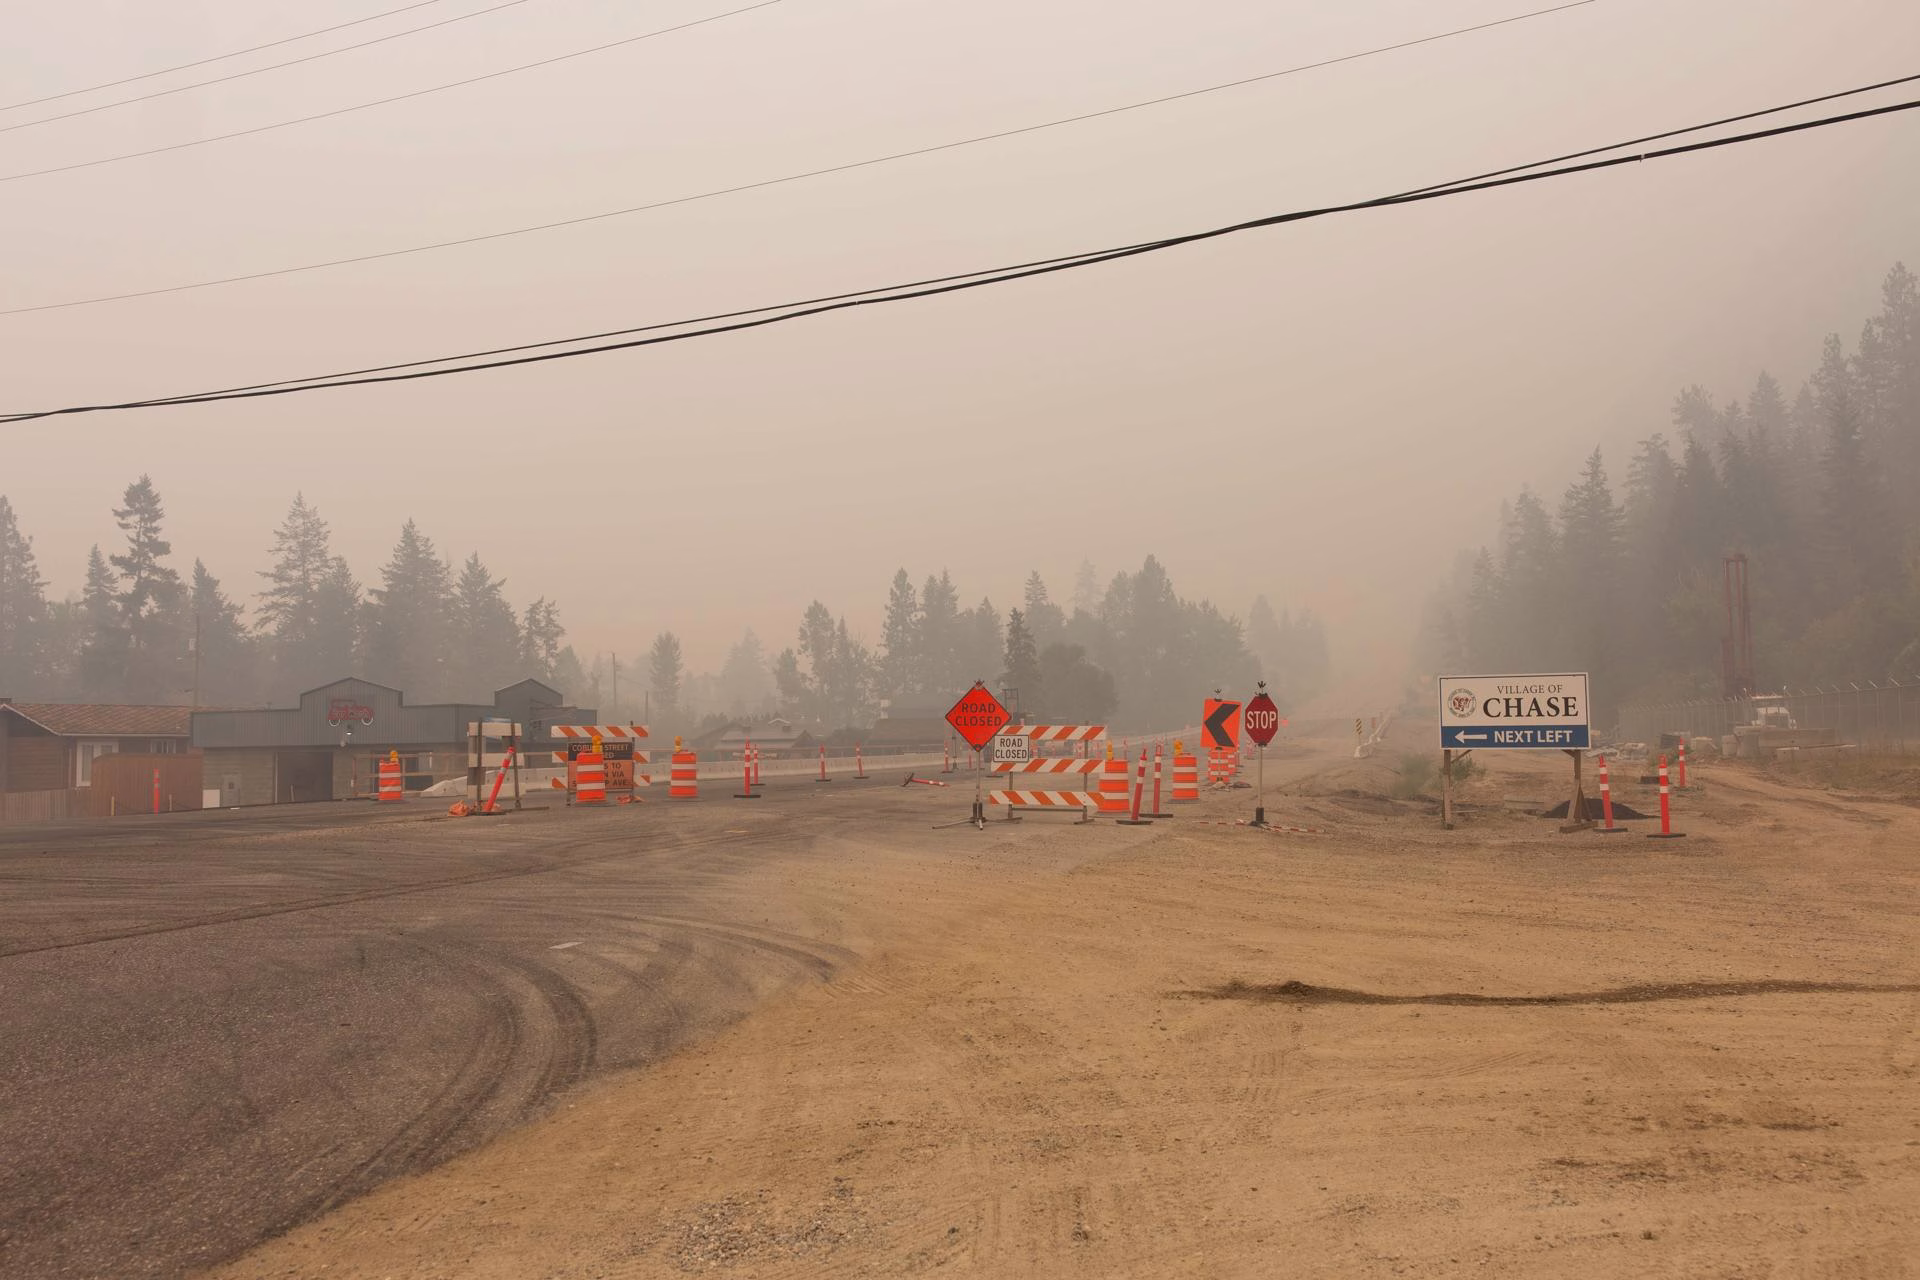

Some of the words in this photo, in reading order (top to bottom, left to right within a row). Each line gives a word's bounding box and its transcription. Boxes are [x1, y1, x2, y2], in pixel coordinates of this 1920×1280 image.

[1497, 685, 1544, 694] VILLAGE
[1548, 684, 1563, 693] OF
[961, 703, 996, 713] ROAD
[1483, 696, 1579, 718] CHASE
[955, 716, 1002, 727] CLOSED
[1246, 710, 1277, 729] STOP
[1494, 730, 1533, 743] NEXT
[1537, 730, 1573, 743] LEFT
[604, 743, 629, 751] STREET
[1000, 738, 1023, 748] ROAD
[995, 749, 1027, 759] CLOSED
